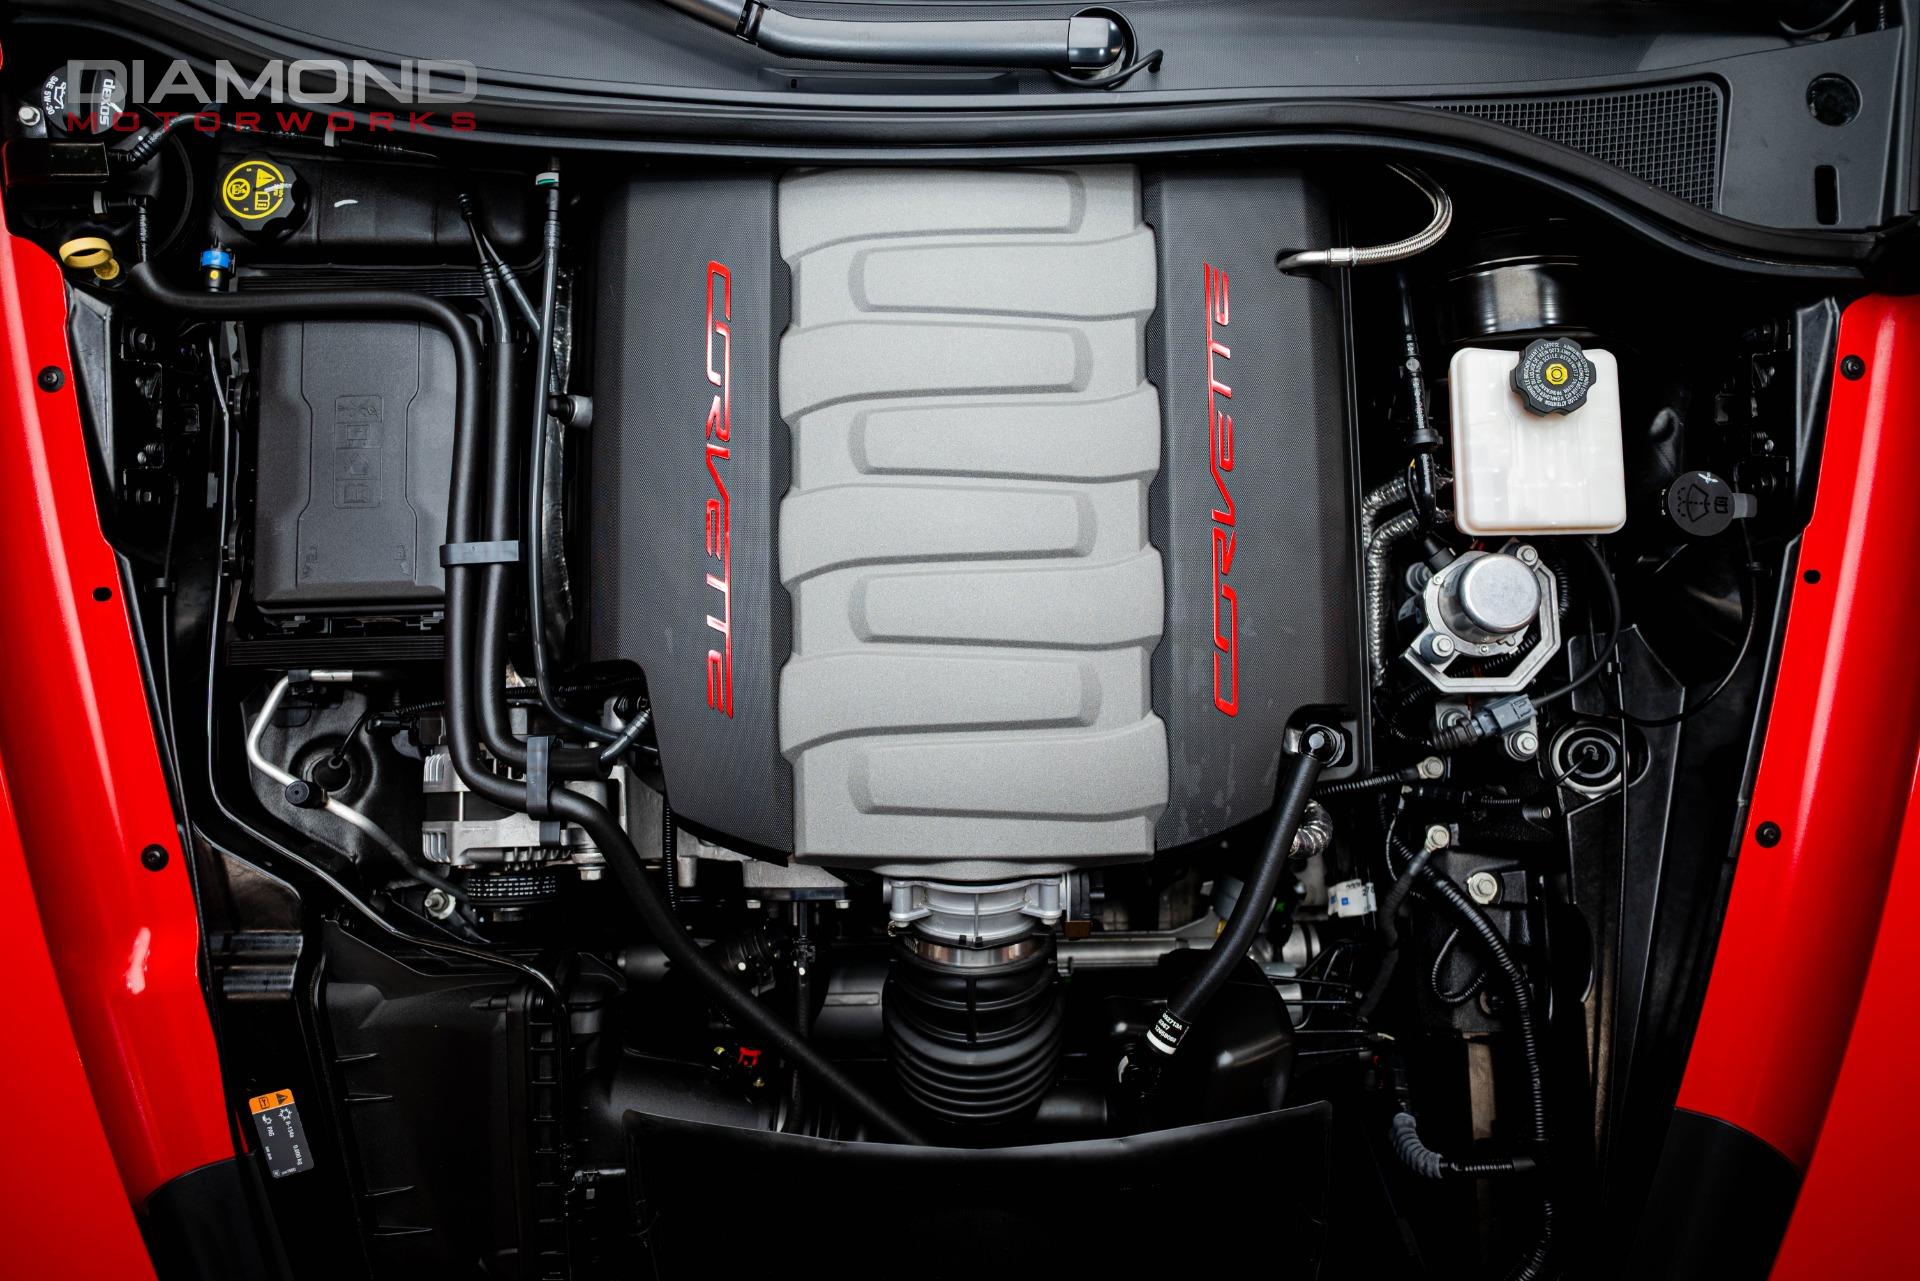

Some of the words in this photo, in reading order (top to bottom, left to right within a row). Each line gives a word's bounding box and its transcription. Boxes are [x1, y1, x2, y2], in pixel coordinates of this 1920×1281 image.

[43, 91, 56, 116] 5W-30
[46, 76, 59, 90] SAE
[100, 79, 116, 127] dexos
[706, 260, 733, 719] CORVETTE
[1204, 262, 1238, 717] CORVETTE
